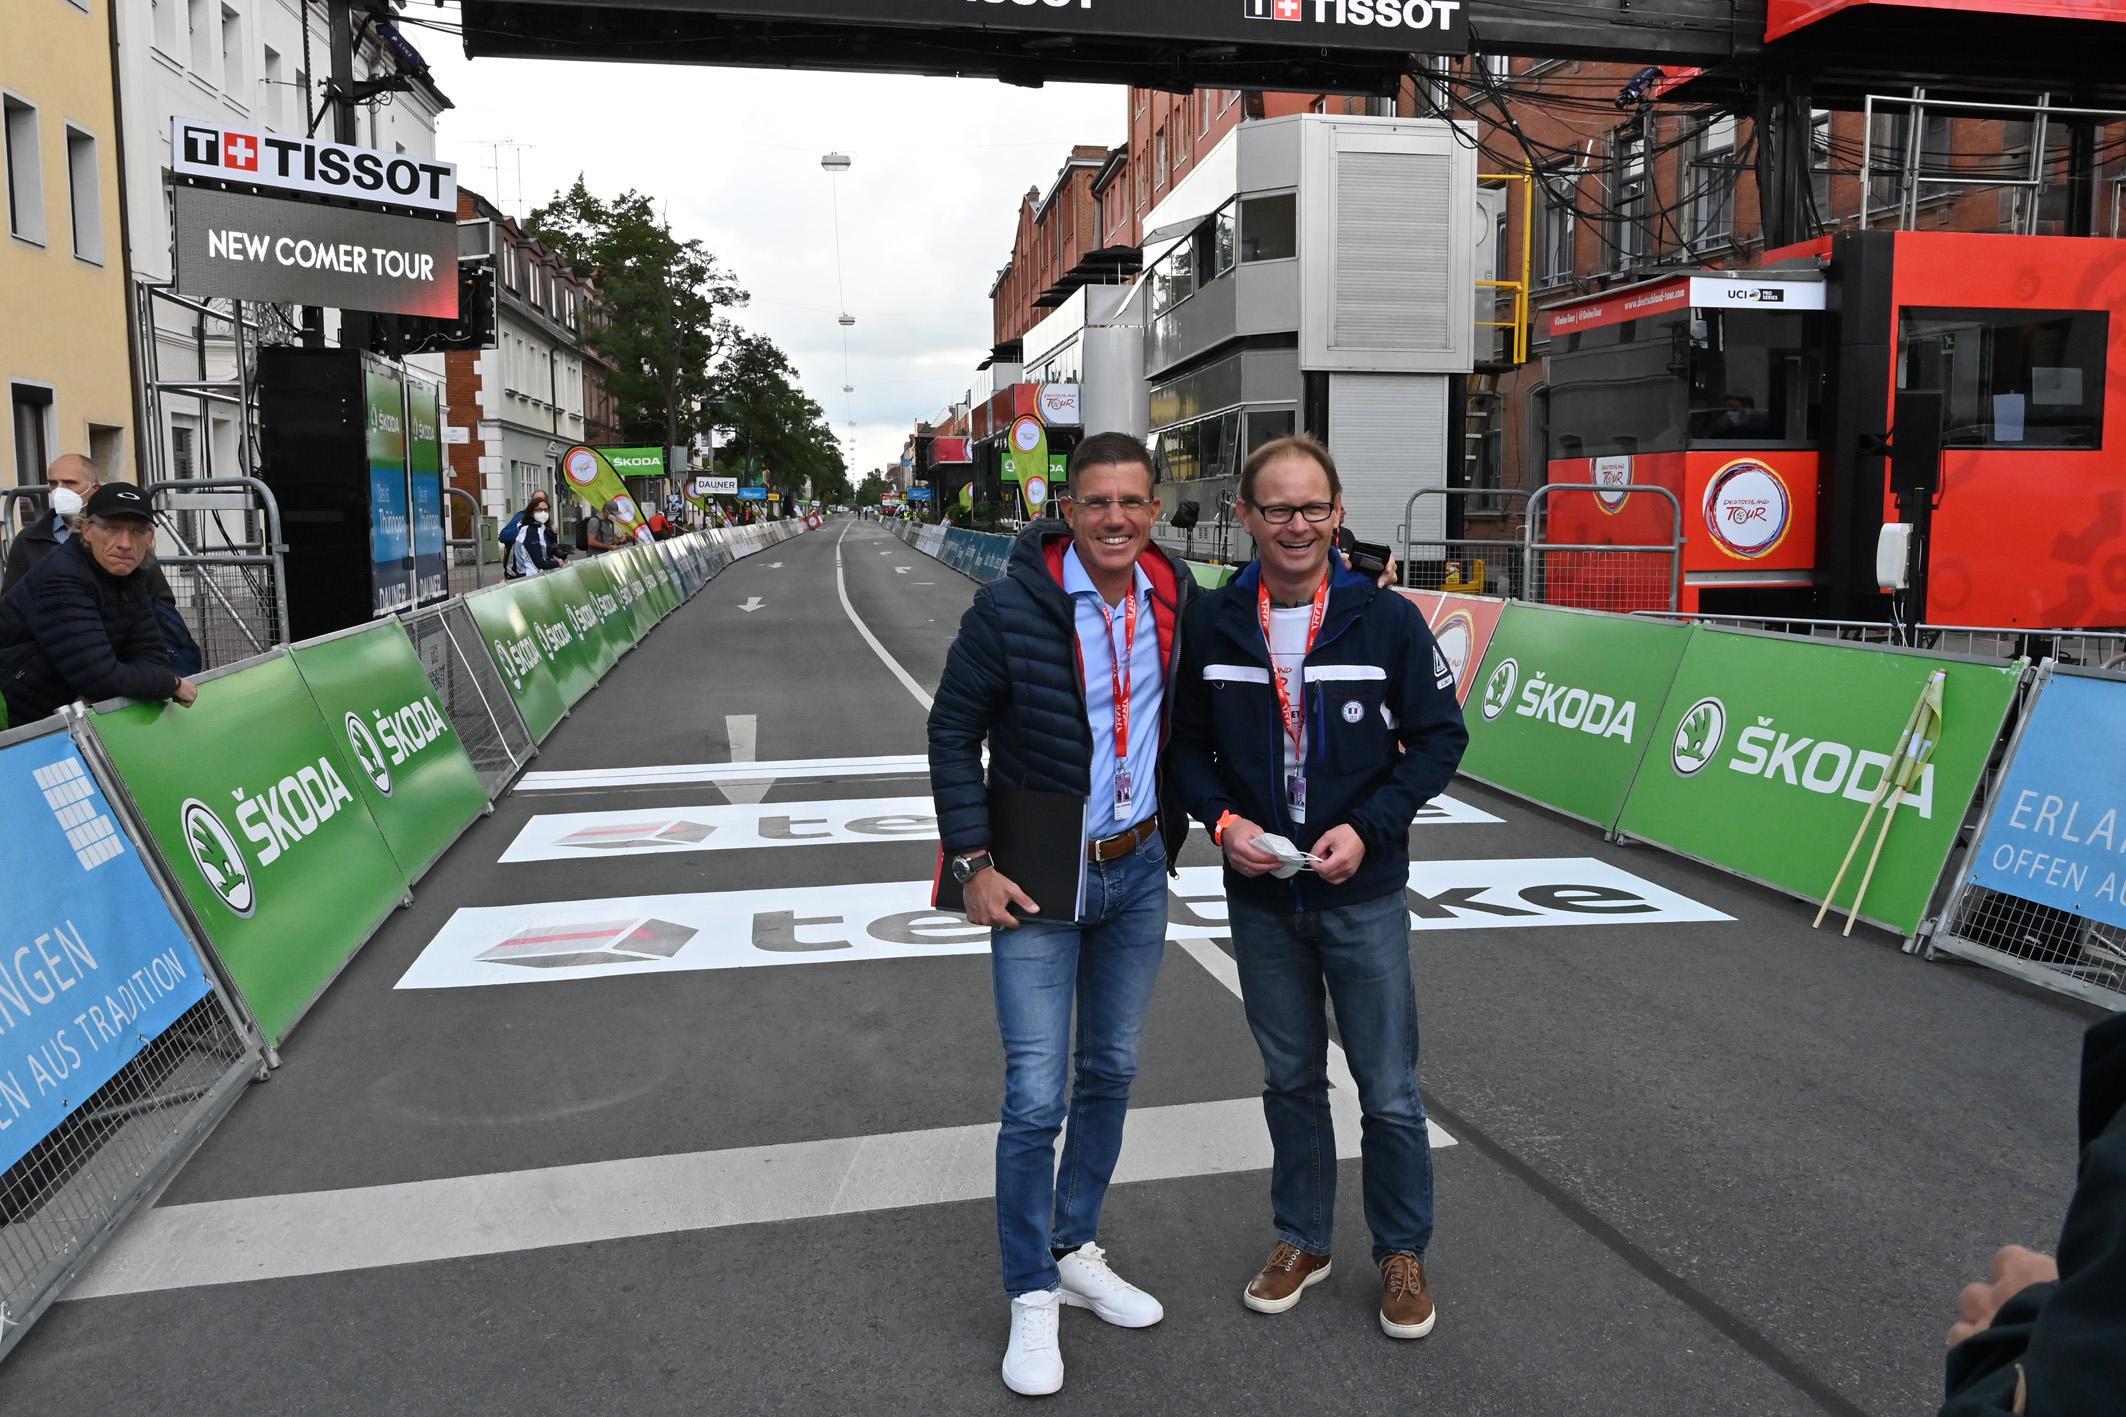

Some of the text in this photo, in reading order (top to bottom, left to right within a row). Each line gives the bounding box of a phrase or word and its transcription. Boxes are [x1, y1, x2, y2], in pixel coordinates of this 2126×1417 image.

[1310, 0, 1460, 30] TISSOT
[265, 138, 451, 200] TISSOT
[208, 229, 434, 282] NEW COMER TOUR
[1728, 290, 1747, 299] UCI
[1046, 398, 1075, 410] TOUR
[613, 456, 662, 467] ŠKODA
[1603, 470, 1624, 486] TOUR
[698, 481, 735, 491] DAUNER
[1727, 507, 1767, 524] TOUR
[507, 635, 542, 676] ŠKODA
[544, 621, 573, 652] ŠKODA
[1515, 671, 1636, 744] ŠKODA
[373, 696, 448, 766] ŠKODA
[1730, 717, 1934, 820] ŠKODA
[232, 756, 353, 867] ŠKODA
[2009, 789, 2126, 854] ERLA
[1993, 844, 2088, 892] OFFEN
[27, 1029, 81, 1096] AUS
[73, 947, 187, 1051] TRADITION
